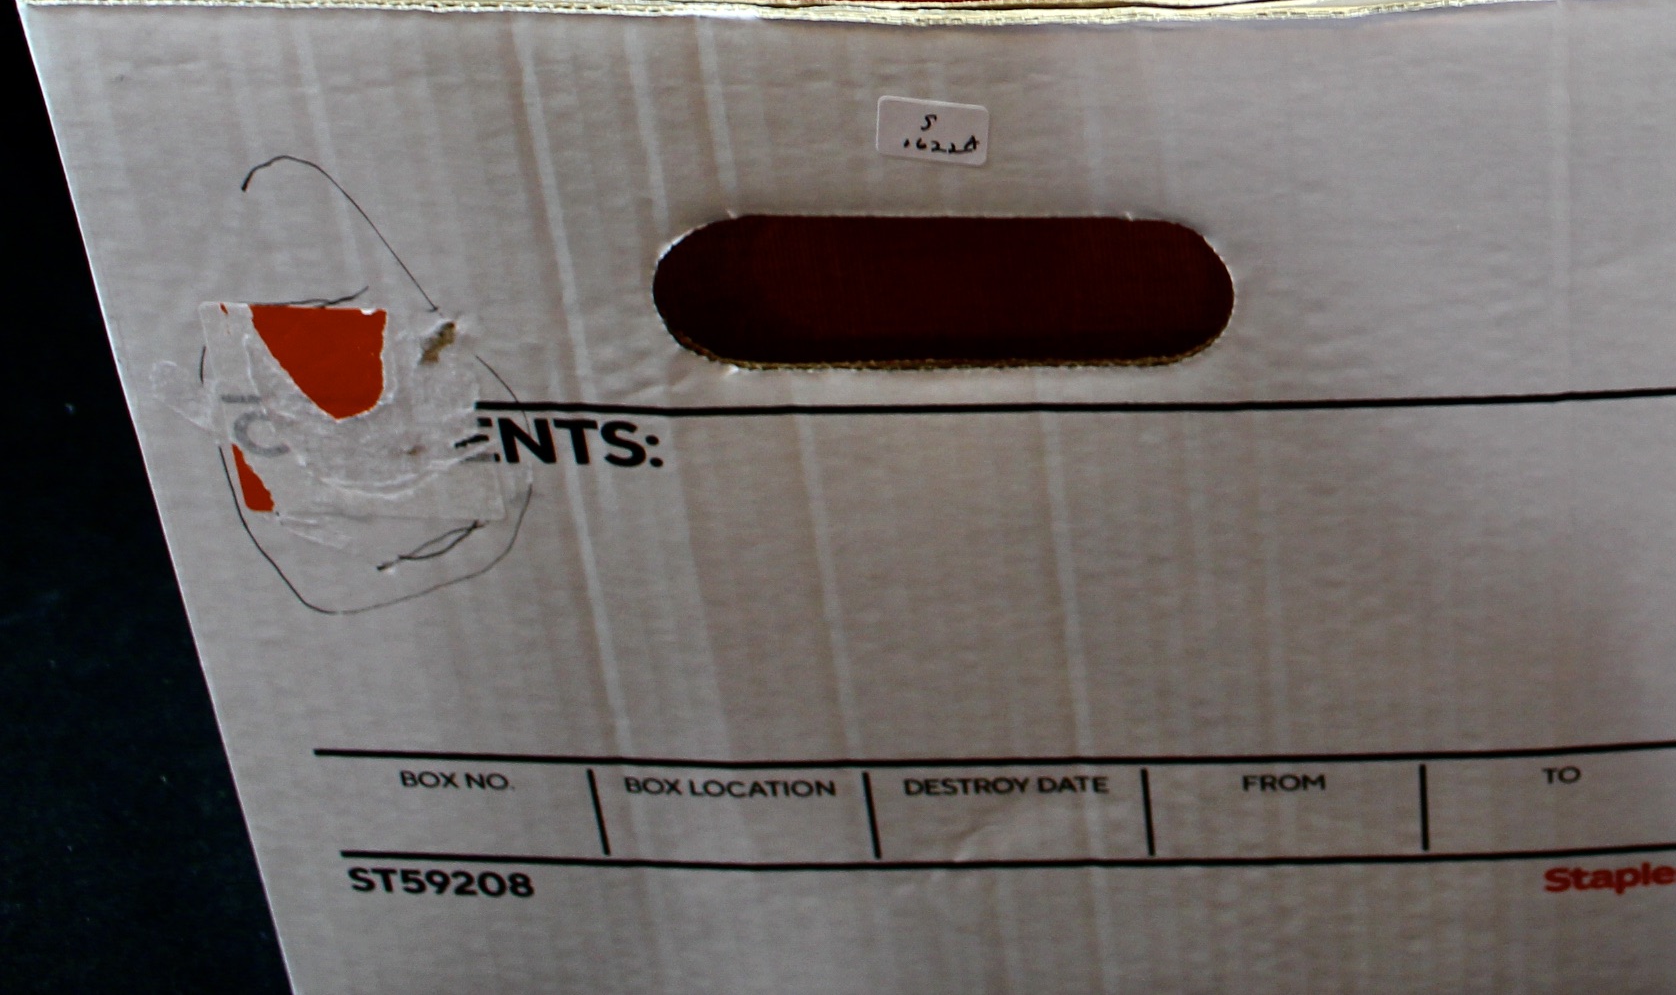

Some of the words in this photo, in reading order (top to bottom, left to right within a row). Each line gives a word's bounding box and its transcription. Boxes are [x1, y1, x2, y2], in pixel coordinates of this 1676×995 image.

[399, 769, 459, 790] BOX
[463, 771, 516, 792] NO.
[902, 776, 1029, 797] DESTROY
[1036, 775, 1110, 794] DATE
[1241, 773, 1327, 793] FROM
[1541, 765, 1582, 786] TO
[623, 775, 682, 797] BOX
[688, 777, 838, 799] LOCATION
[347, 866, 535, 899] ST59208
